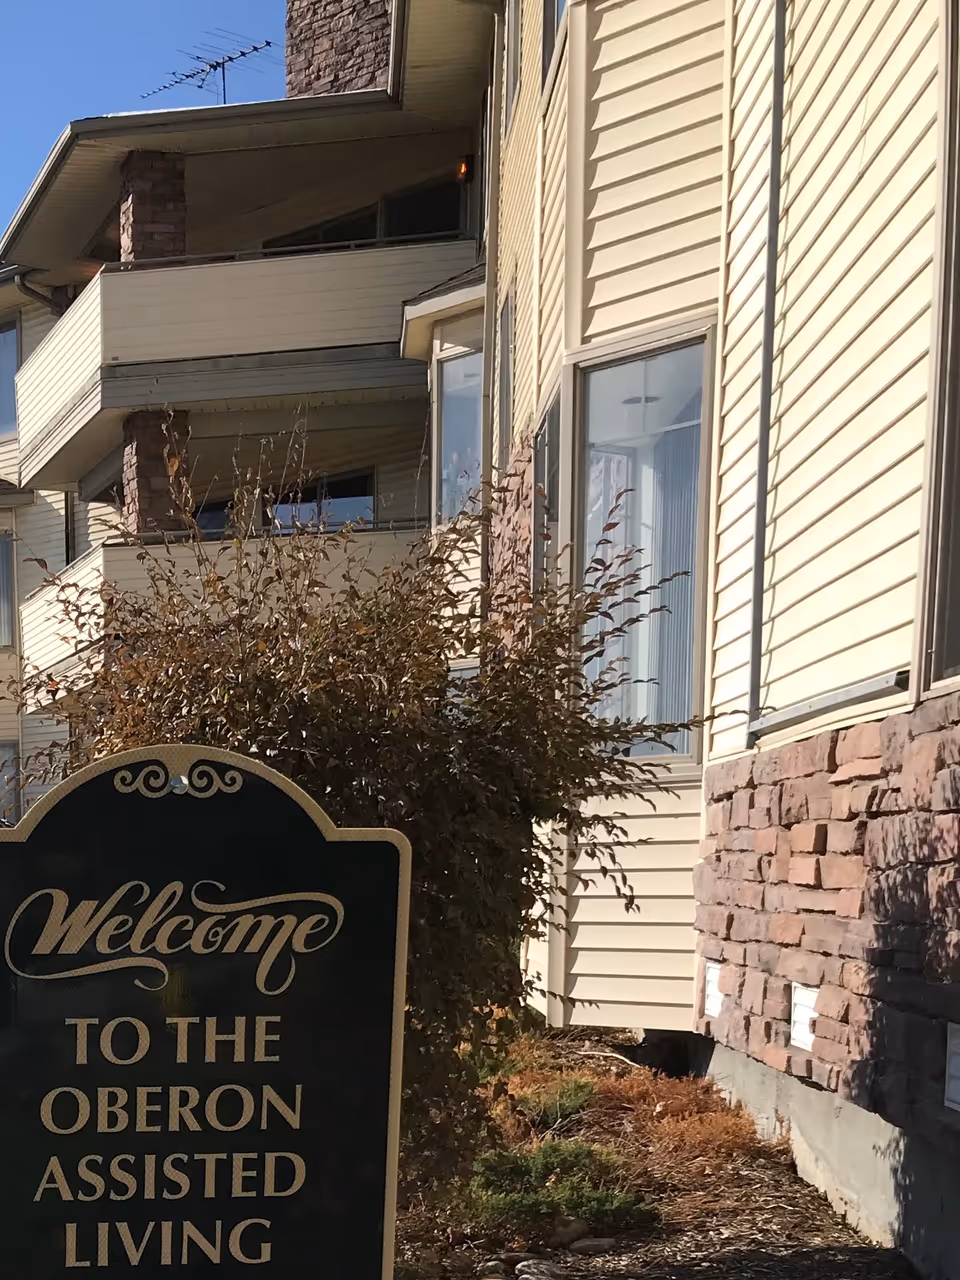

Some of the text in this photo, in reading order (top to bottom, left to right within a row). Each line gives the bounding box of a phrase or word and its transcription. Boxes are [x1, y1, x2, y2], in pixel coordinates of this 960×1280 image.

[5, 880, 345, 996] Welcome
[64, 1015, 281, 1065] TO THE
[40, 1084, 302, 1135] OBERON
[33, 1152, 306, 1202] ASSISTED
[65, 1218, 272, 1268] LIVING
